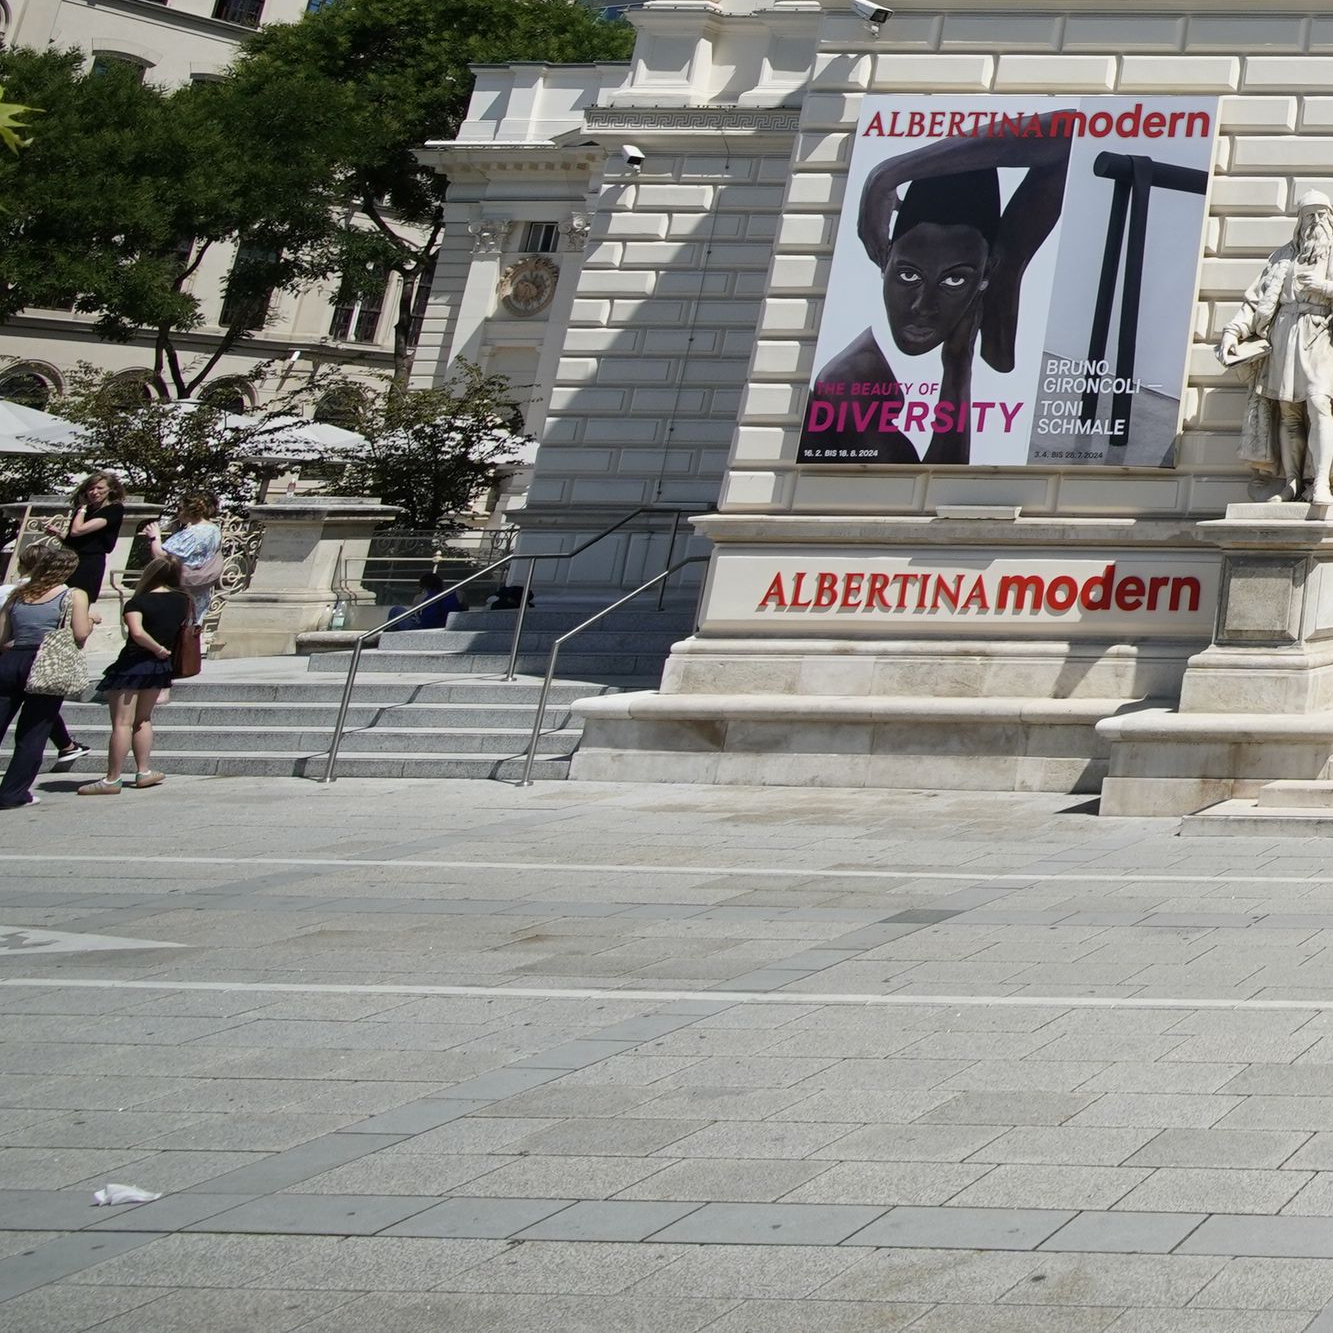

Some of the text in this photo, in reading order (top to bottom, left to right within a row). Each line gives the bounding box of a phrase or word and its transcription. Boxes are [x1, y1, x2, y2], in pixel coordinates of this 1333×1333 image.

[862, 103, 1210, 139] ALBERTINA modern
[1046, 360, 1110, 376] BRUNO
[815, 381, 940, 396] THE BEAUTY OF
[1043, 377, 1141, 394] GIRONCOLI
[1040, 400, 1084, 417] TONI
[807, 401, 1025, 434] DIVERSITY
[1036, 419, 1126, 436] SCHMALE
[824, 449, 838, 457] BIS
[858, 449, 879, 457] 2024
[758, 564, 1201, 612] ALBERTINA modern
